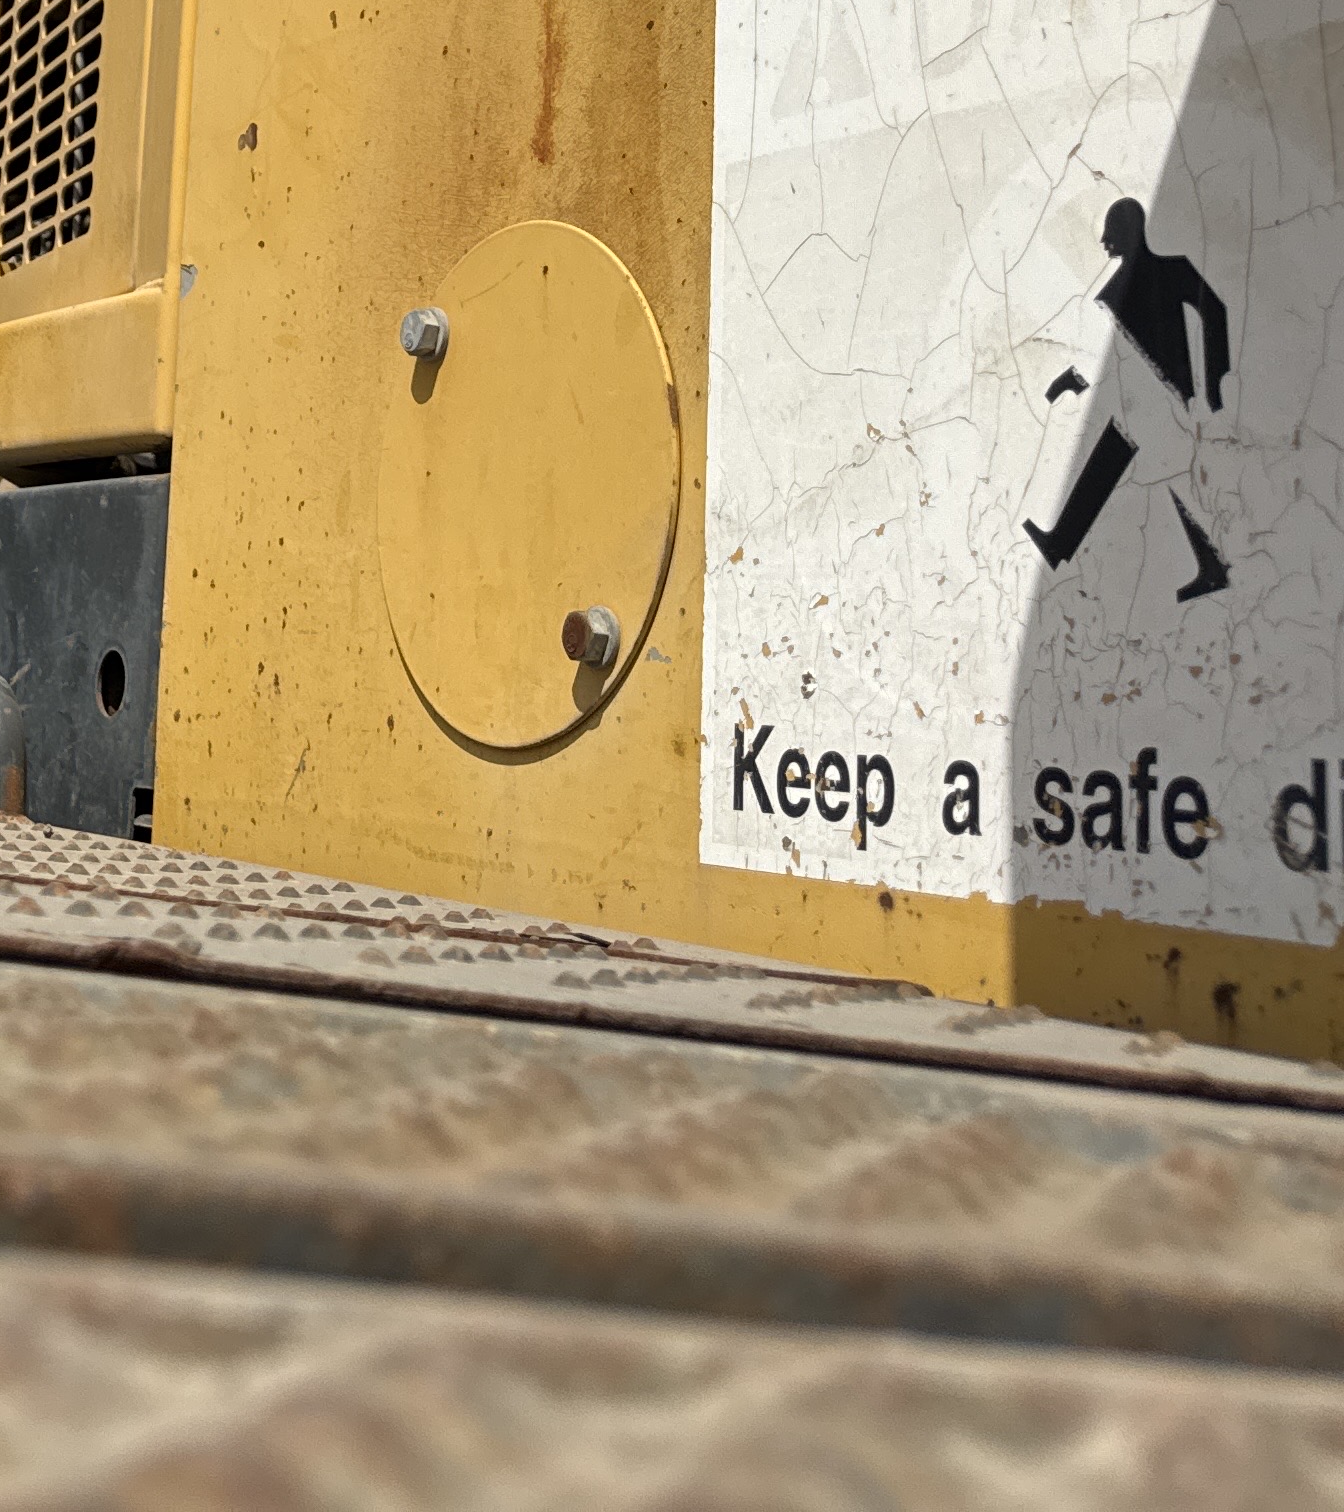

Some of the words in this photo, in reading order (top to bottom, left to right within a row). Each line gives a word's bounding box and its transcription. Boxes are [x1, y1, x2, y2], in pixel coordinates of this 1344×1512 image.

[732, 724, 895, 851] Keep
[942, 759, 982, 837] a
[1032, 747, 1210, 859] safe
